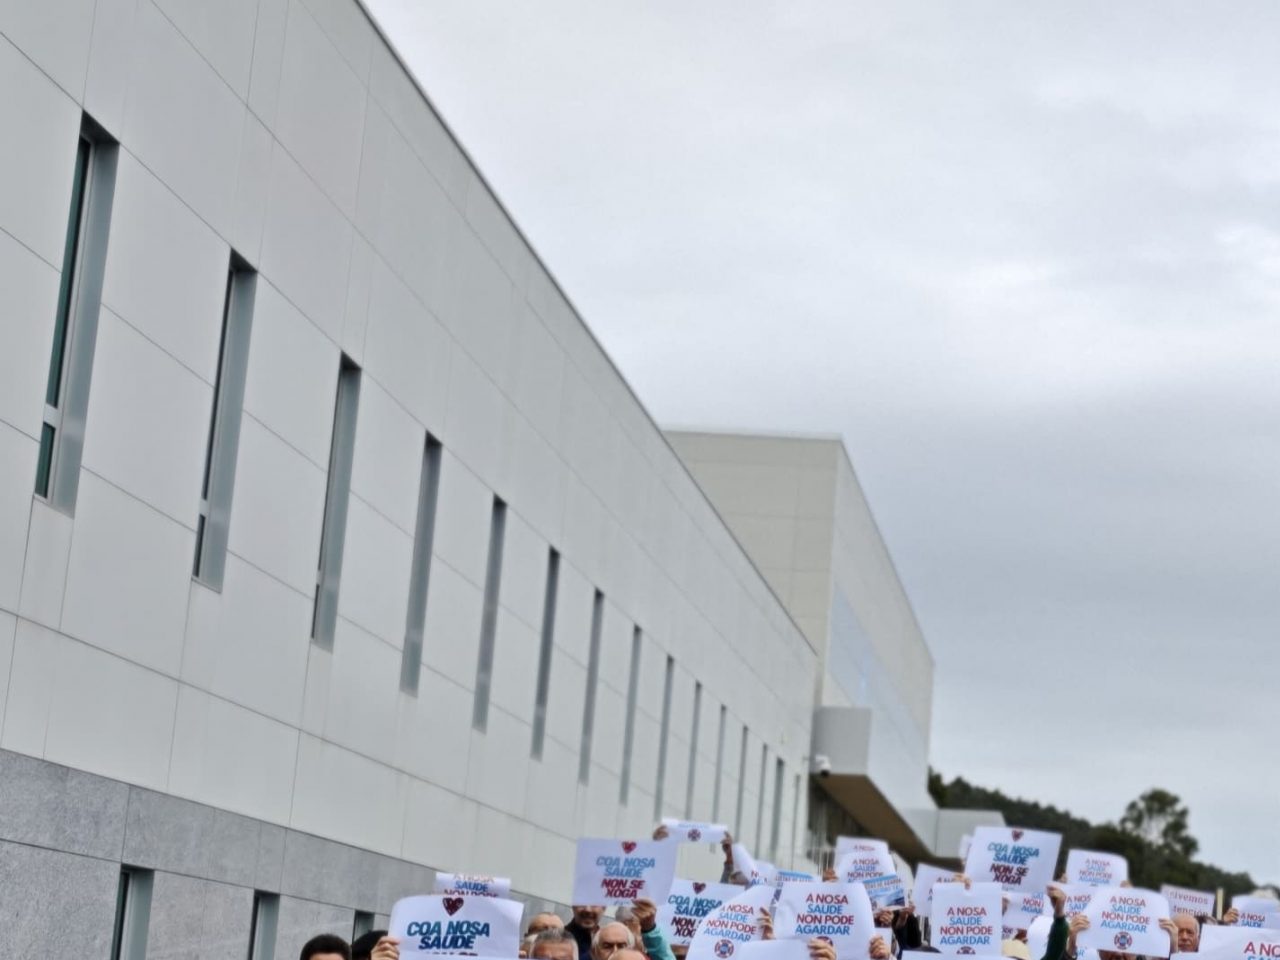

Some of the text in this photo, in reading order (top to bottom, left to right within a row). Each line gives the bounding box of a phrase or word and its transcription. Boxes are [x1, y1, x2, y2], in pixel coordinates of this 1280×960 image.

[816, 895, 848, 904] NOSA
[955, 907, 987, 916] NOSA
[797, 914, 854, 924] NON PODE
[407, 921, 490, 937] COA NOSA
[707, 920, 756, 934] NON PODE
[796, 925, 849, 935] AGARDAR
[940, 926, 993, 935] NON PODE
[940, 936, 990, 944] AGARDAR
[1244, 942, 1255, 954] A
